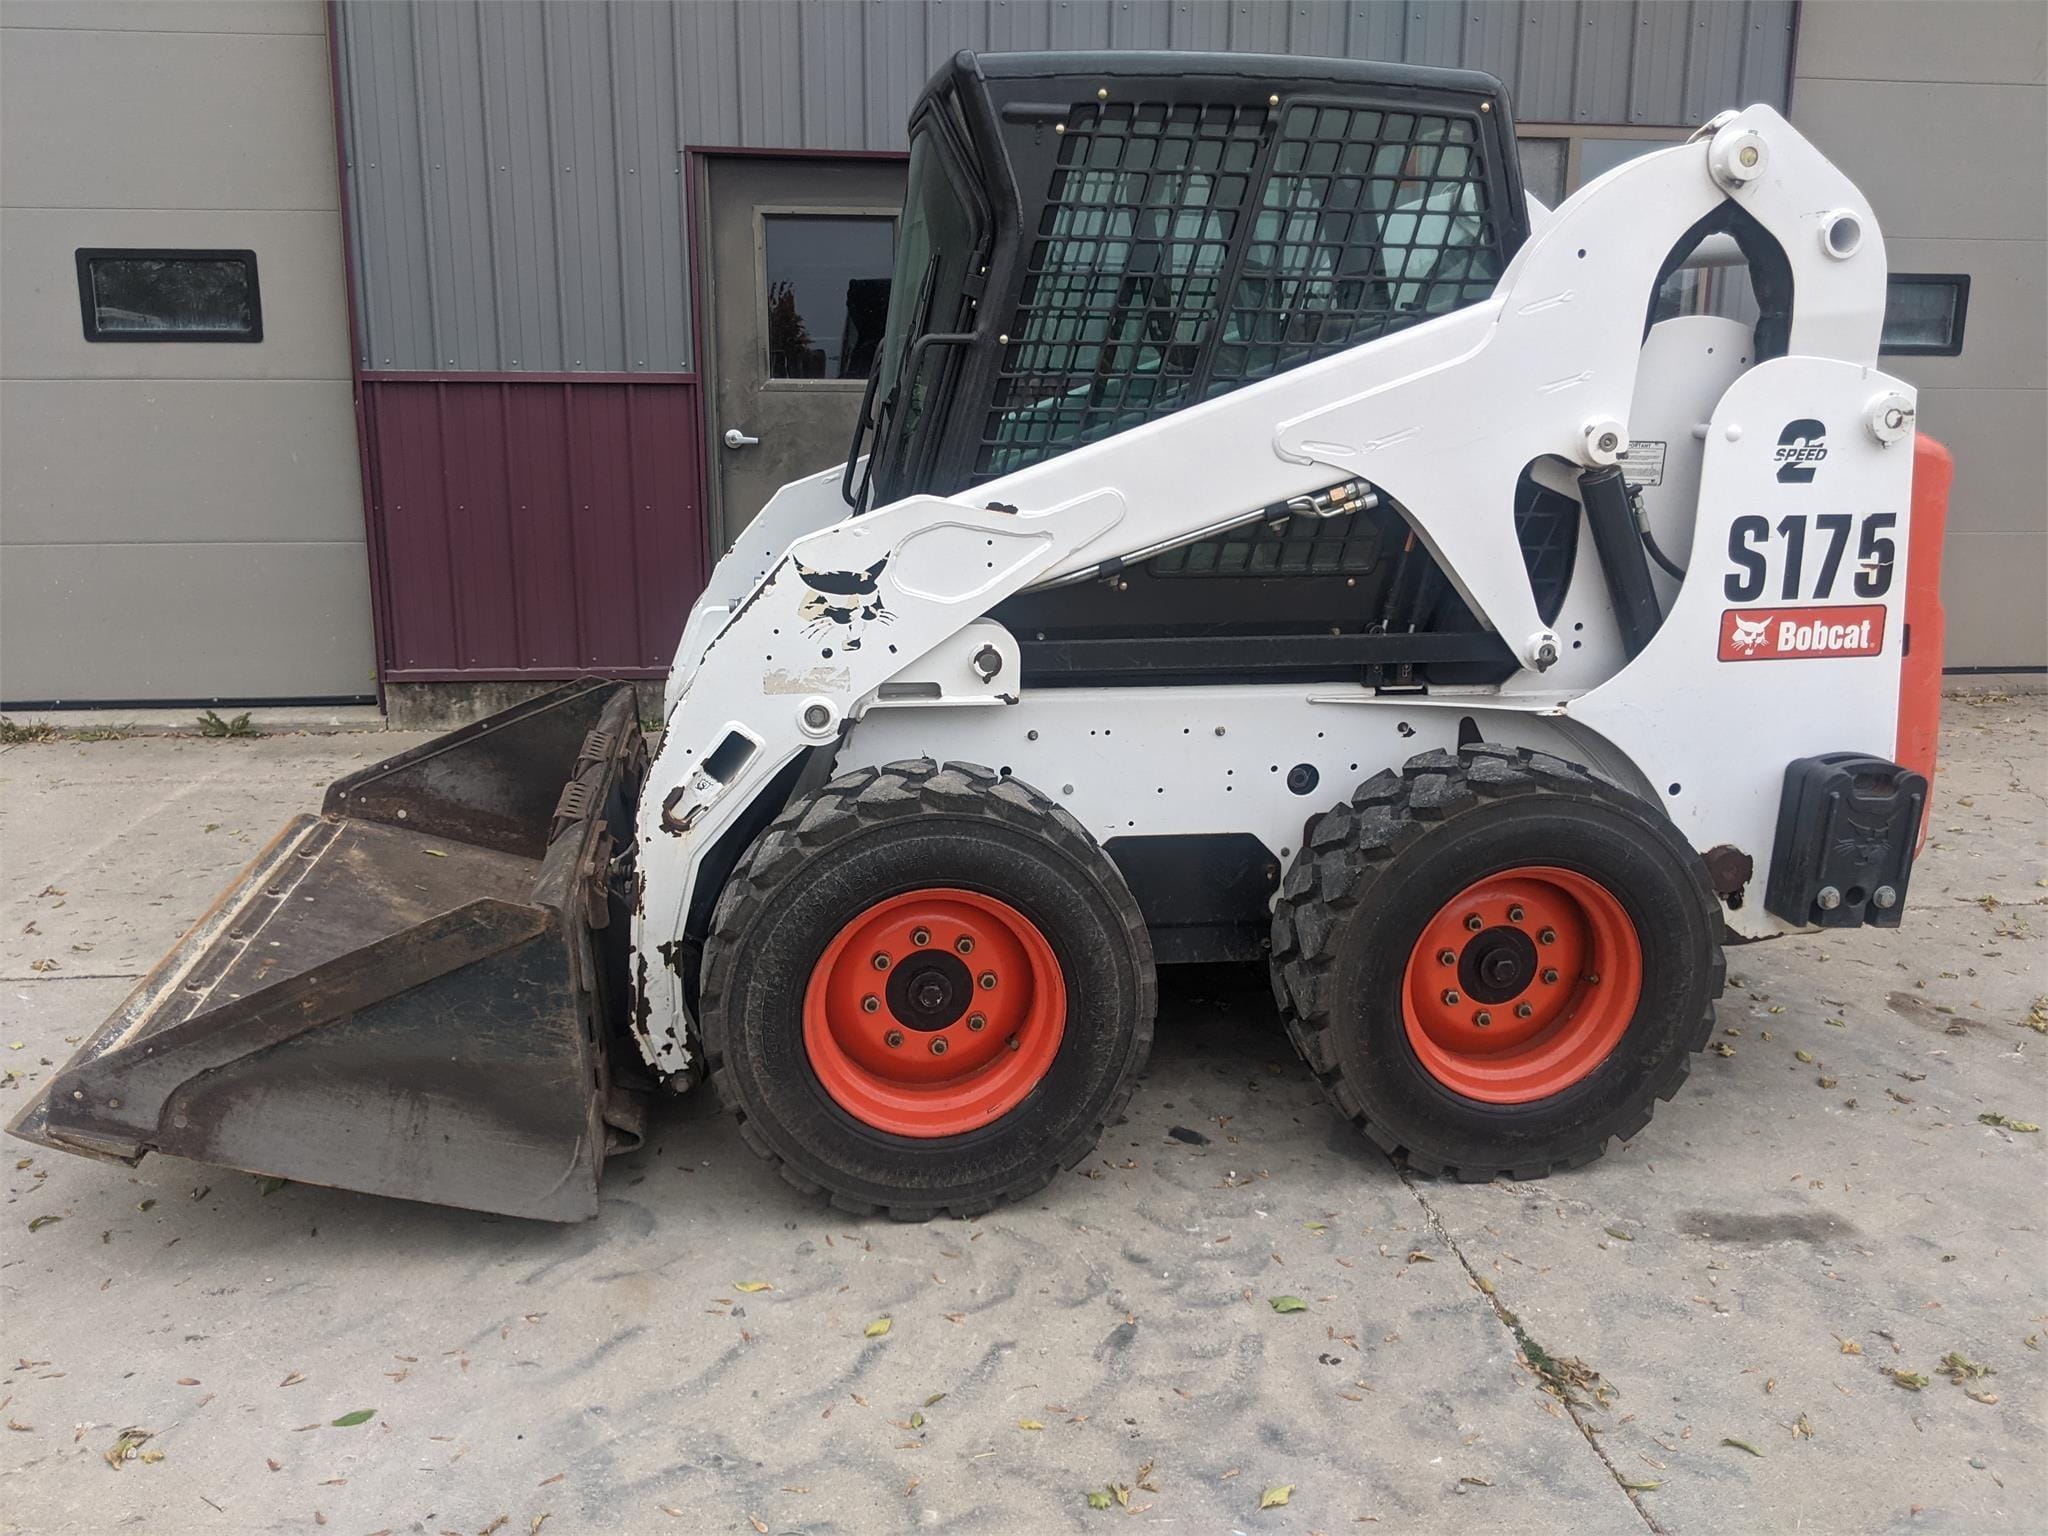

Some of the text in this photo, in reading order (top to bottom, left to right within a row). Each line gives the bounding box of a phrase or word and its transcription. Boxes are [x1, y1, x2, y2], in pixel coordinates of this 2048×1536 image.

[1773, 448, 1828, 461] SPEED
[1776, 418, 1826, 484] 2
[1724, 512, 1897, 602] S175
[1777, 619, 1871, 652] Bobcat
